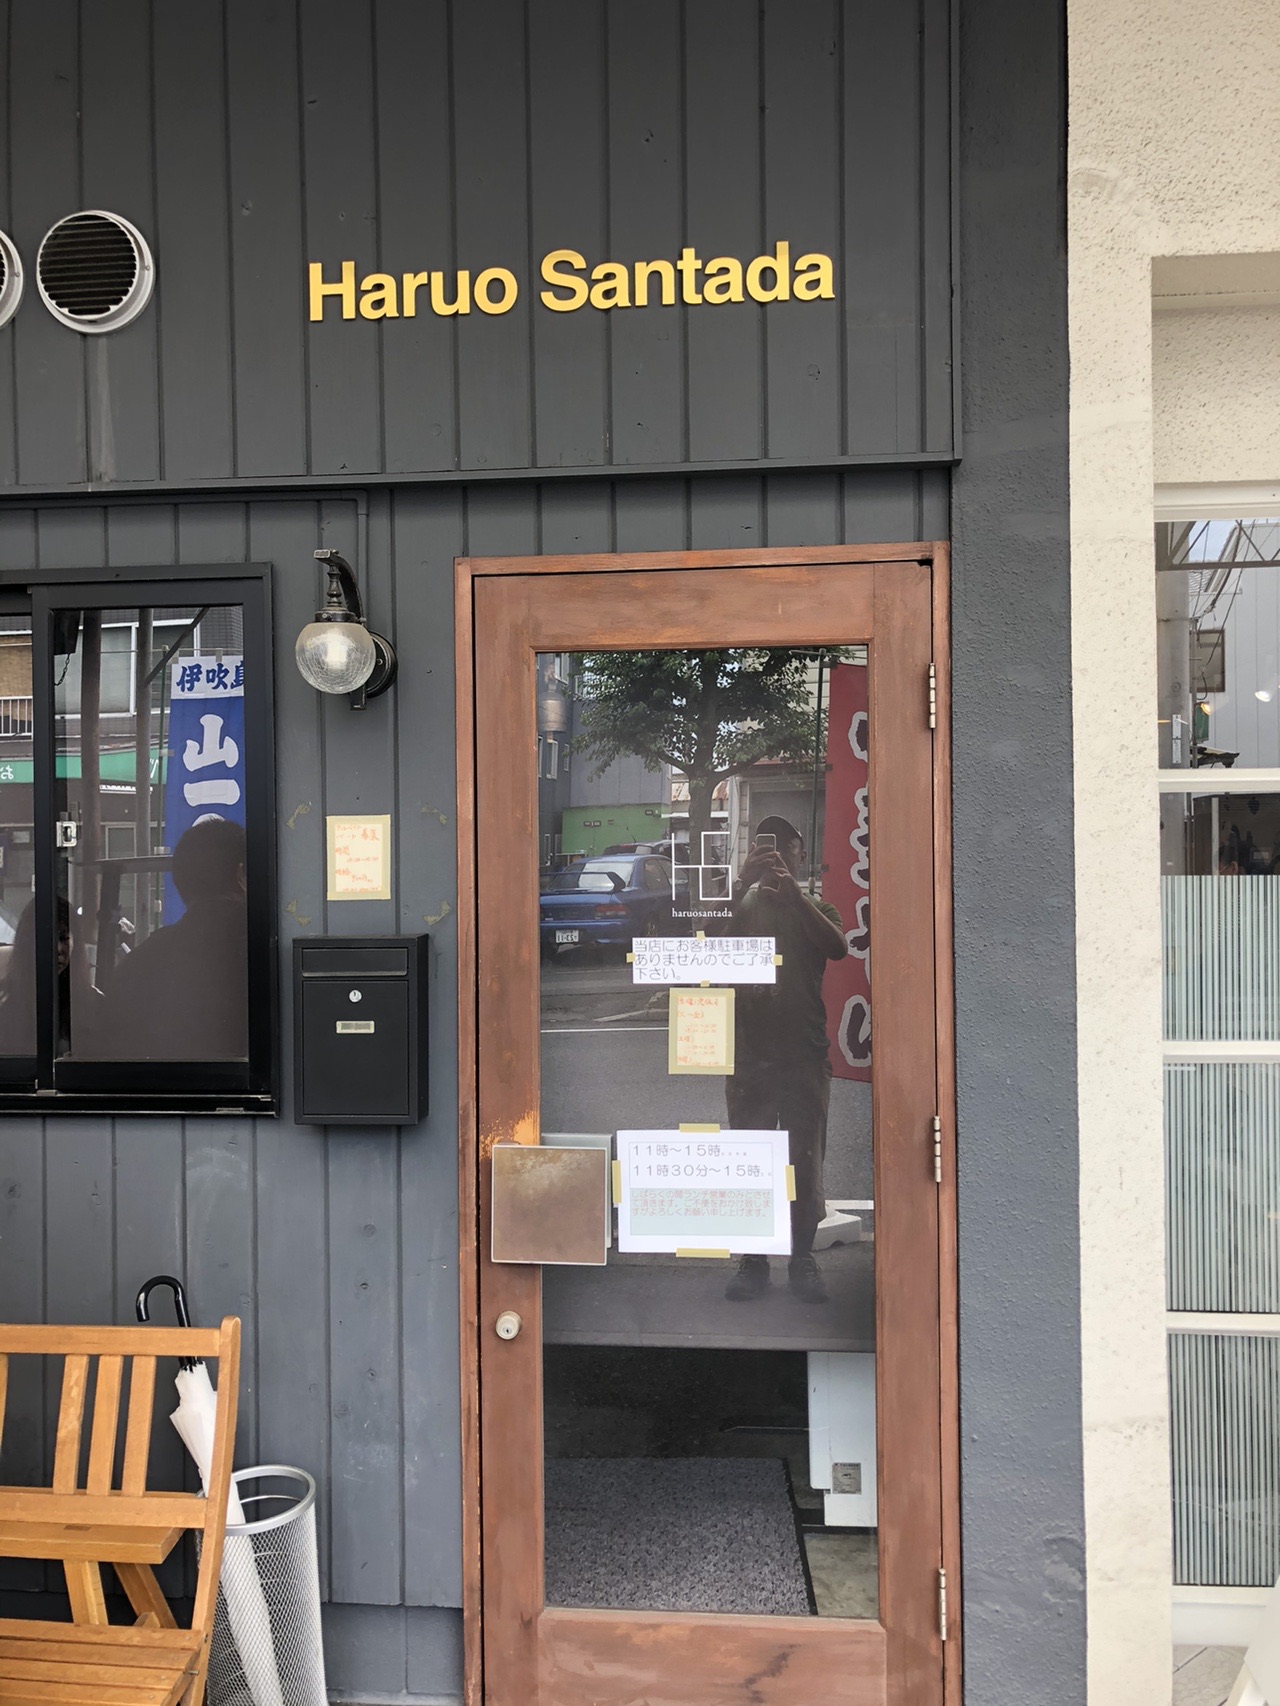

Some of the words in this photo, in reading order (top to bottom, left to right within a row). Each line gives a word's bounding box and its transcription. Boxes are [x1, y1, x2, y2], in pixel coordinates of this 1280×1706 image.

[308, 260, 519, 322] Haruo
[540, 240, 836, 313] Santada
[671, 907, 733, 918] haruosantada
[634, 939, 773, 953] 当店にお客様駐車場は
[634, 953, 774, 967] ありませんのでご了承
[634, 968, 682, 981] 下さい。
